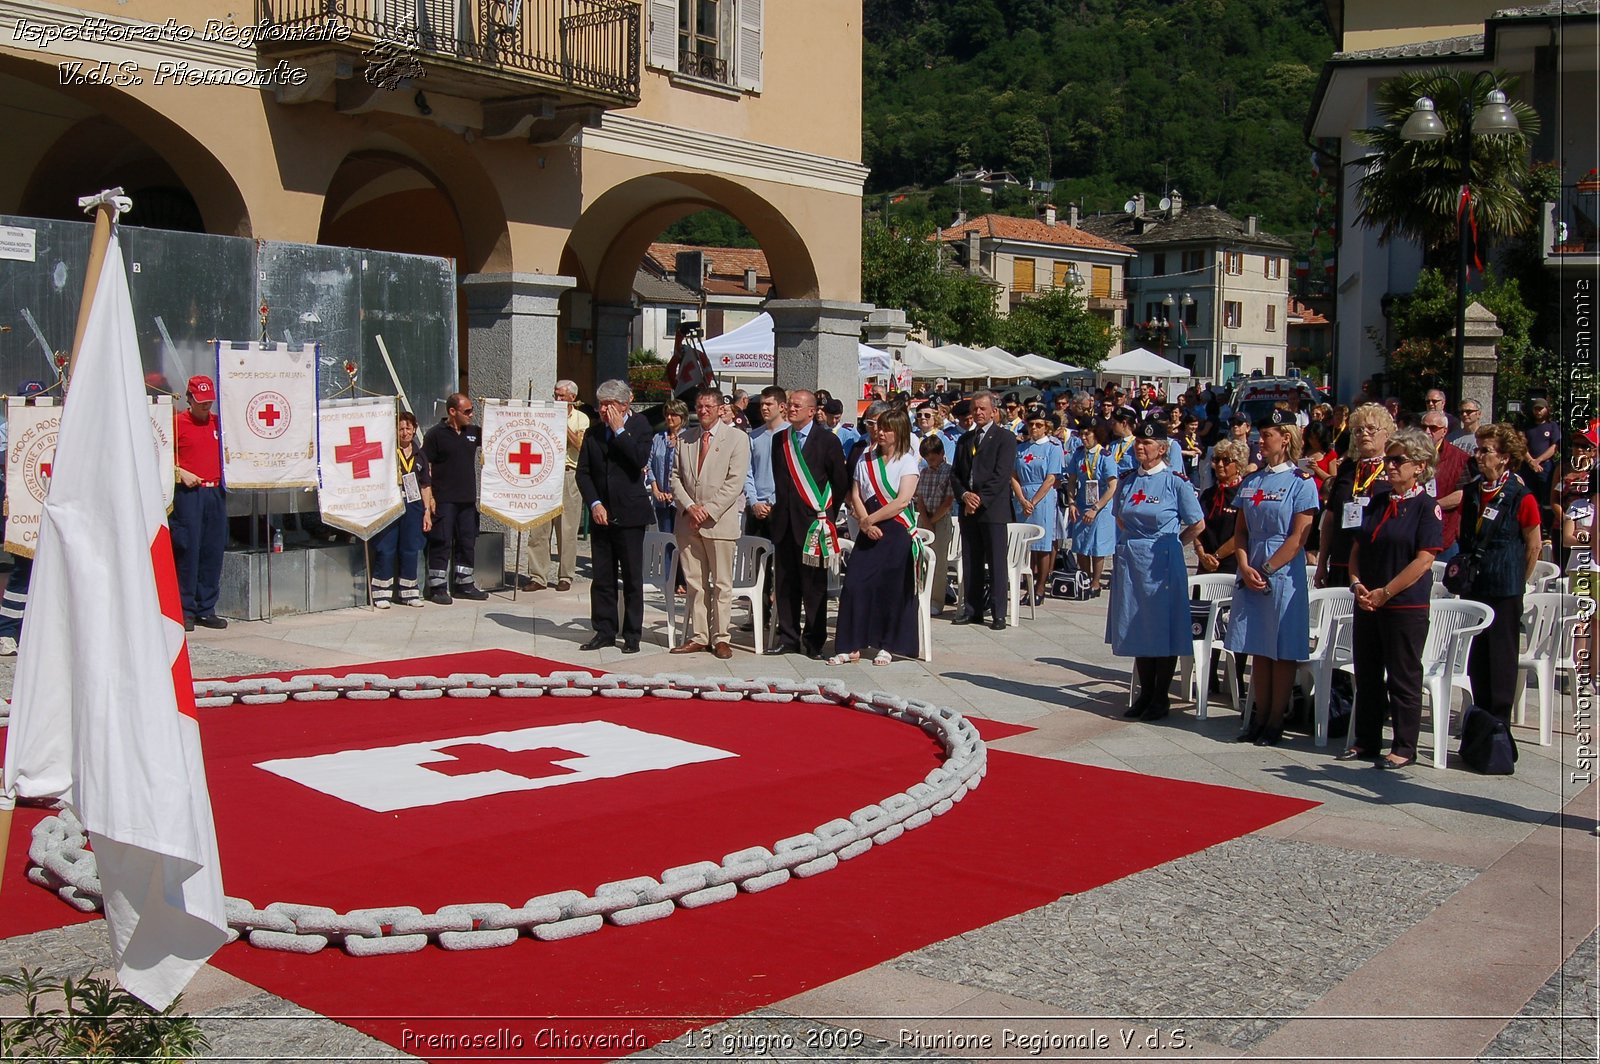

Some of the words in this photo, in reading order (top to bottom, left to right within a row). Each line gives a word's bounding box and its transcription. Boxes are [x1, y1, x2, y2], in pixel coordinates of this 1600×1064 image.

[735, 353, 758, 361] CROCE
[734, 361, 759, 369] COMITATO
[254, 371, 278, 379] ROSSA
[11, 428, 36, 464] CROCE
[36, 417, 61, 433] ROSS
[485, 426, 506, 455] CROCE
[506, 418, 536, 429] ROSSA
[538, 422, 564, 453] ITALIANA
[506, 435, 514, 443] DI
[37, 441, 45, 451] DI
[337, 483, 386, 495] DELEGAZIONE
[492, 492, 526, 500] COMITATO
[528, 492, 554, 501] LOCALE
[327, 501, 377, 513] GRAVELLONA
[508, 501, 538, 510] FIANO
